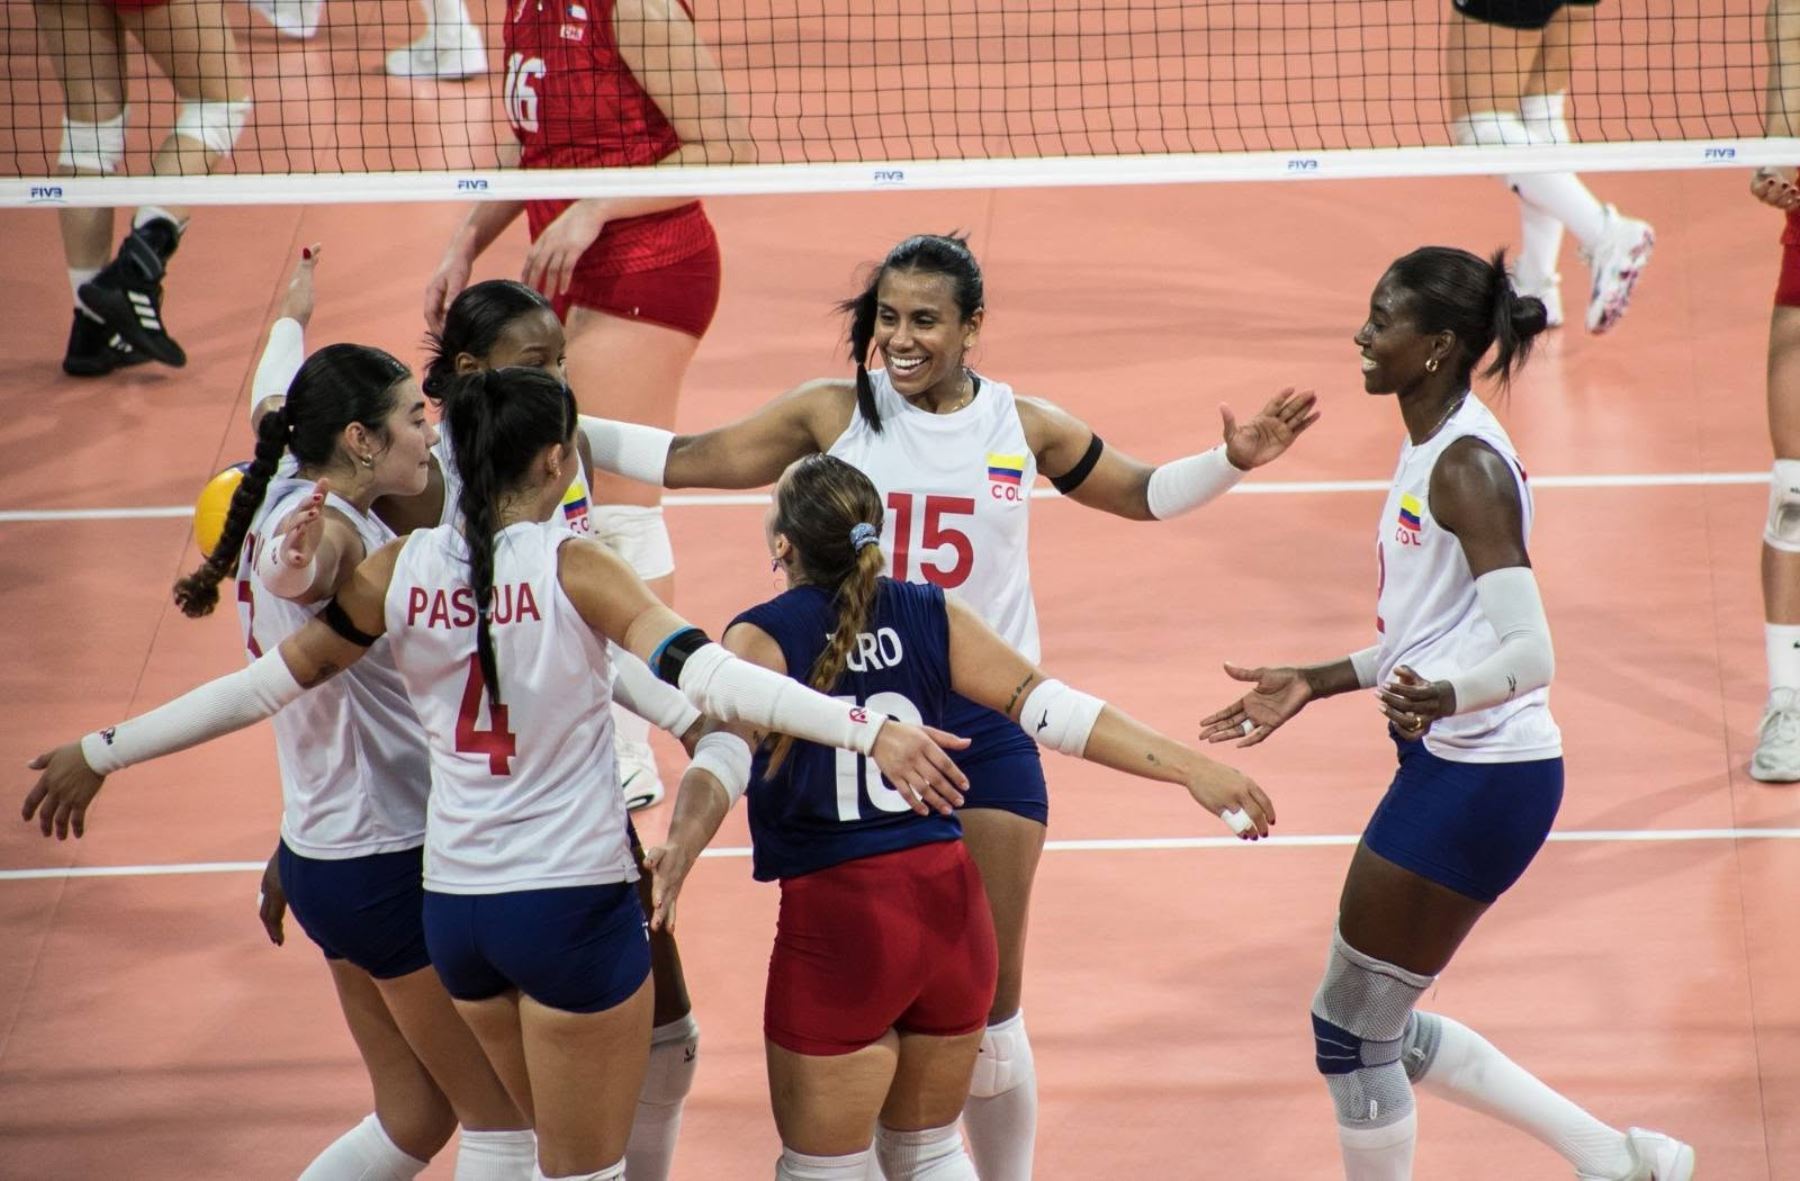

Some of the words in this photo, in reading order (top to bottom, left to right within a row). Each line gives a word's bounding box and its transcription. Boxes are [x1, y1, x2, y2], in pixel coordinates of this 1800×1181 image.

[504, 51, 547, 133] 16
[991, 484, 1023, 501] COL
[887, 491, 976, 589] 15
[406, 581, 542, 630] PASUA
[825, 626, 904, 673] RO
[454, 650, 517, 777] 4
